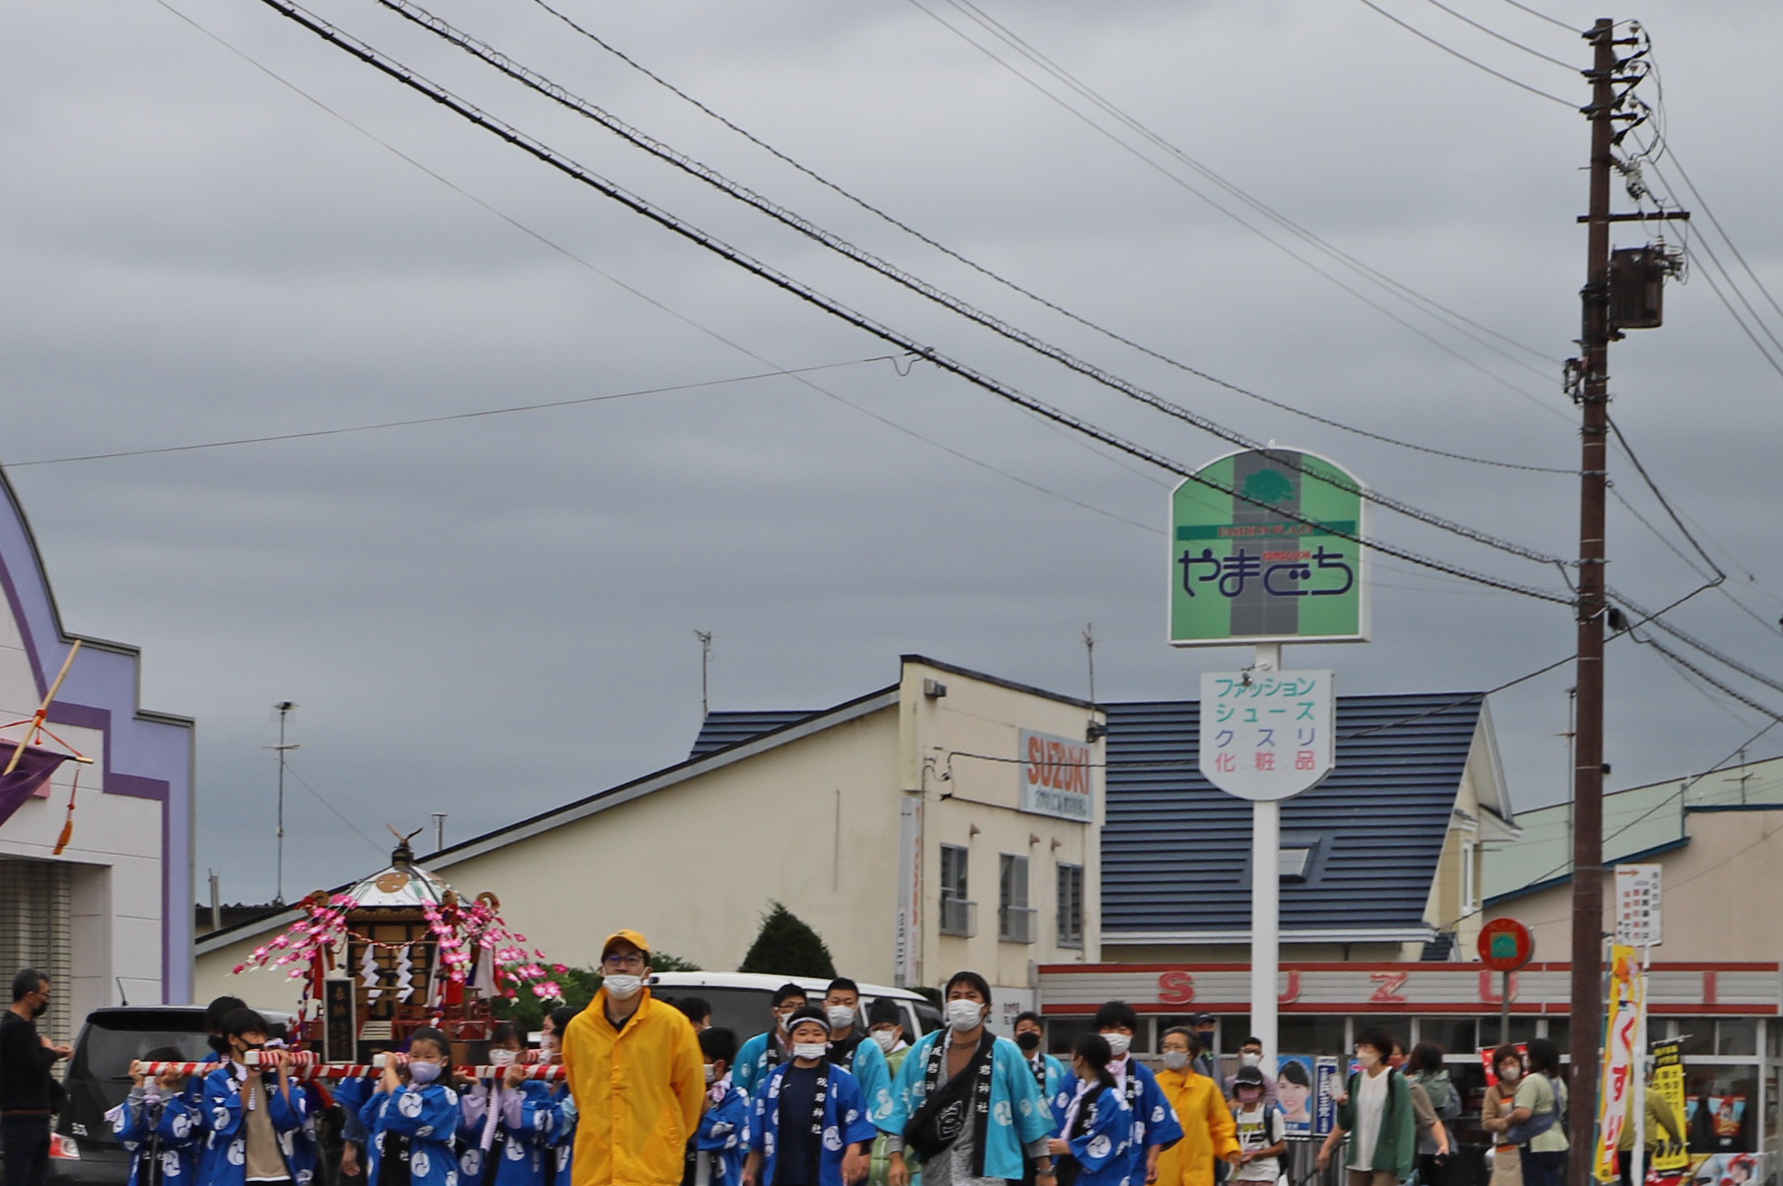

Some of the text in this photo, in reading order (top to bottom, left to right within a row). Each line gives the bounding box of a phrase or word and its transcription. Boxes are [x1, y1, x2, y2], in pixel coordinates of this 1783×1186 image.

[1177, 546, 1354, 598] やまぐち
[1215, 677, 1316, 698] ファッション
[1215, 727, 1315, 749] クスリ
[1028, 735, 1090, 796] SUZUKI
[1215, 750, 1315, 773] 化粧品
